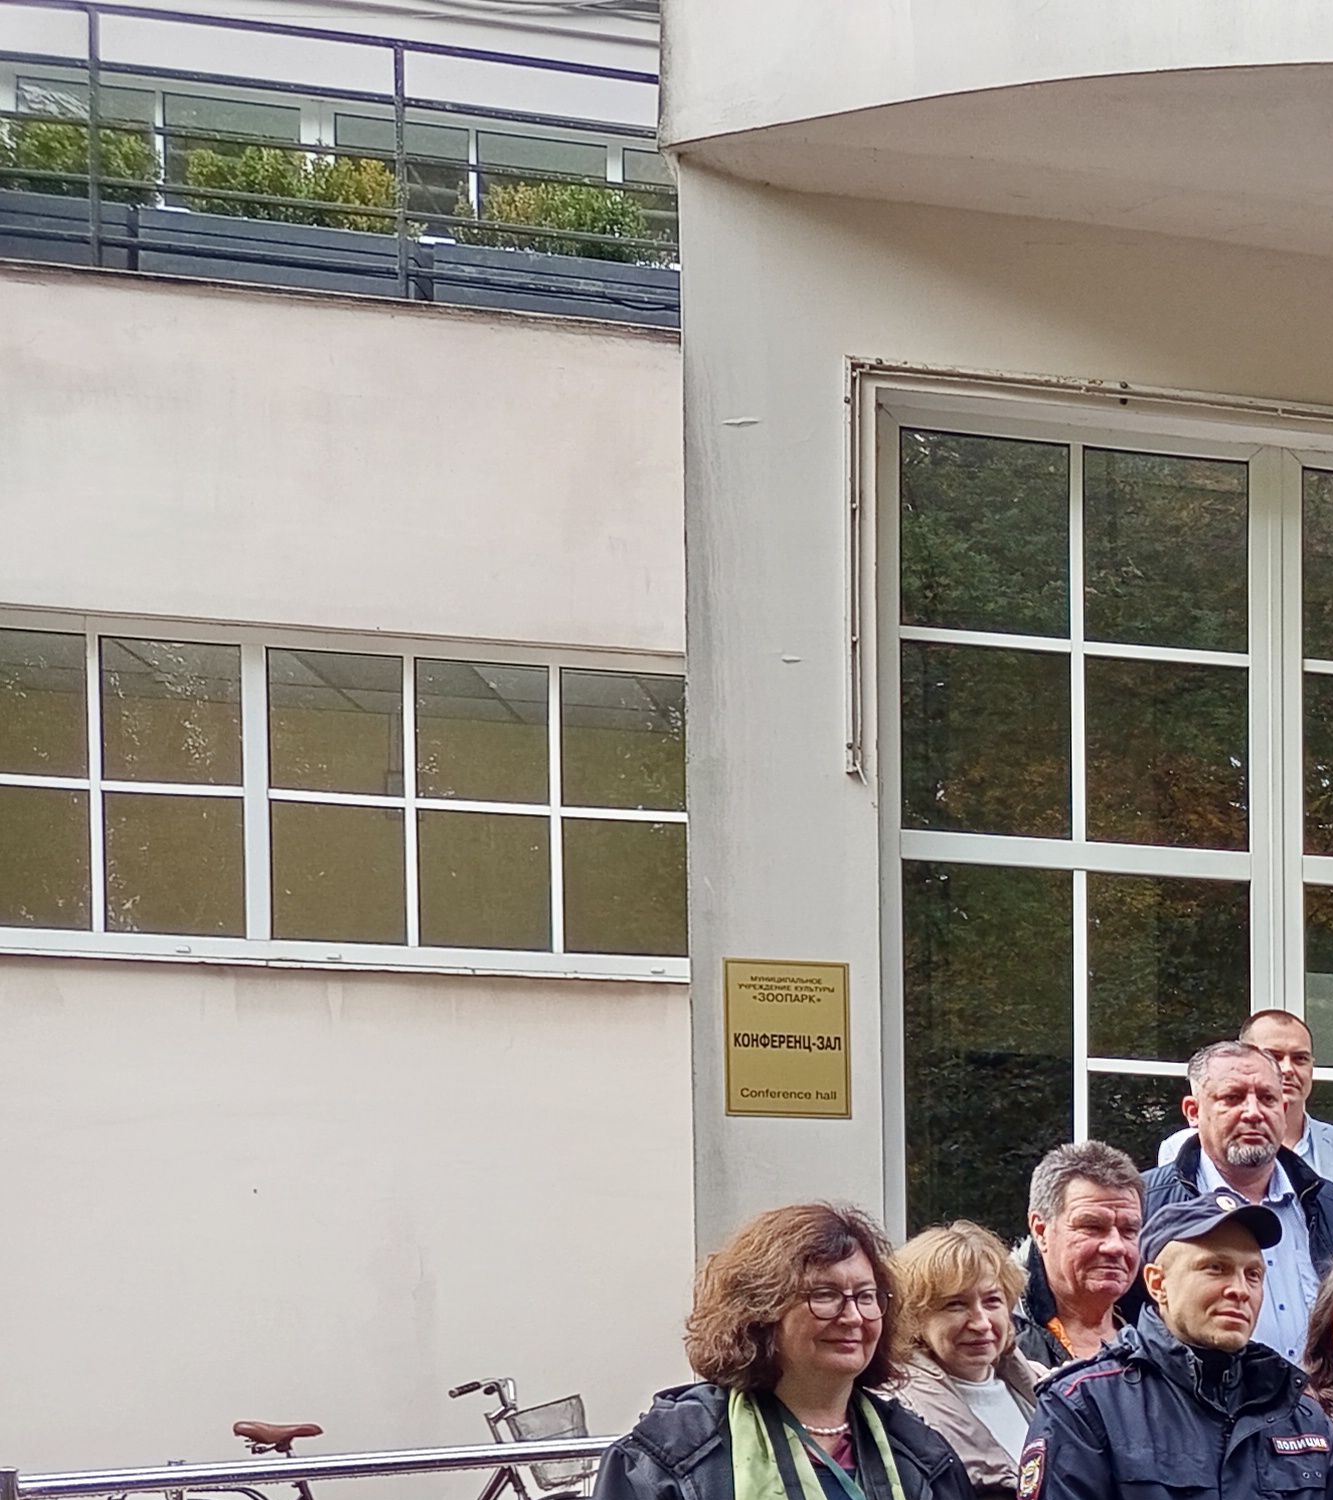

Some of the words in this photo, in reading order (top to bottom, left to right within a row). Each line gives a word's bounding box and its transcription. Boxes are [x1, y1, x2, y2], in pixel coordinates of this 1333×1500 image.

[733, 1033, 842, 1053] КОНФЕРЕНЦ-ЗАЛ
[740, 1087, 812, 1100] Conference
[815, 1090, 837, 1100] hall
[1275, 1437, 1328, 1450] ПОЛИЦИЯ
